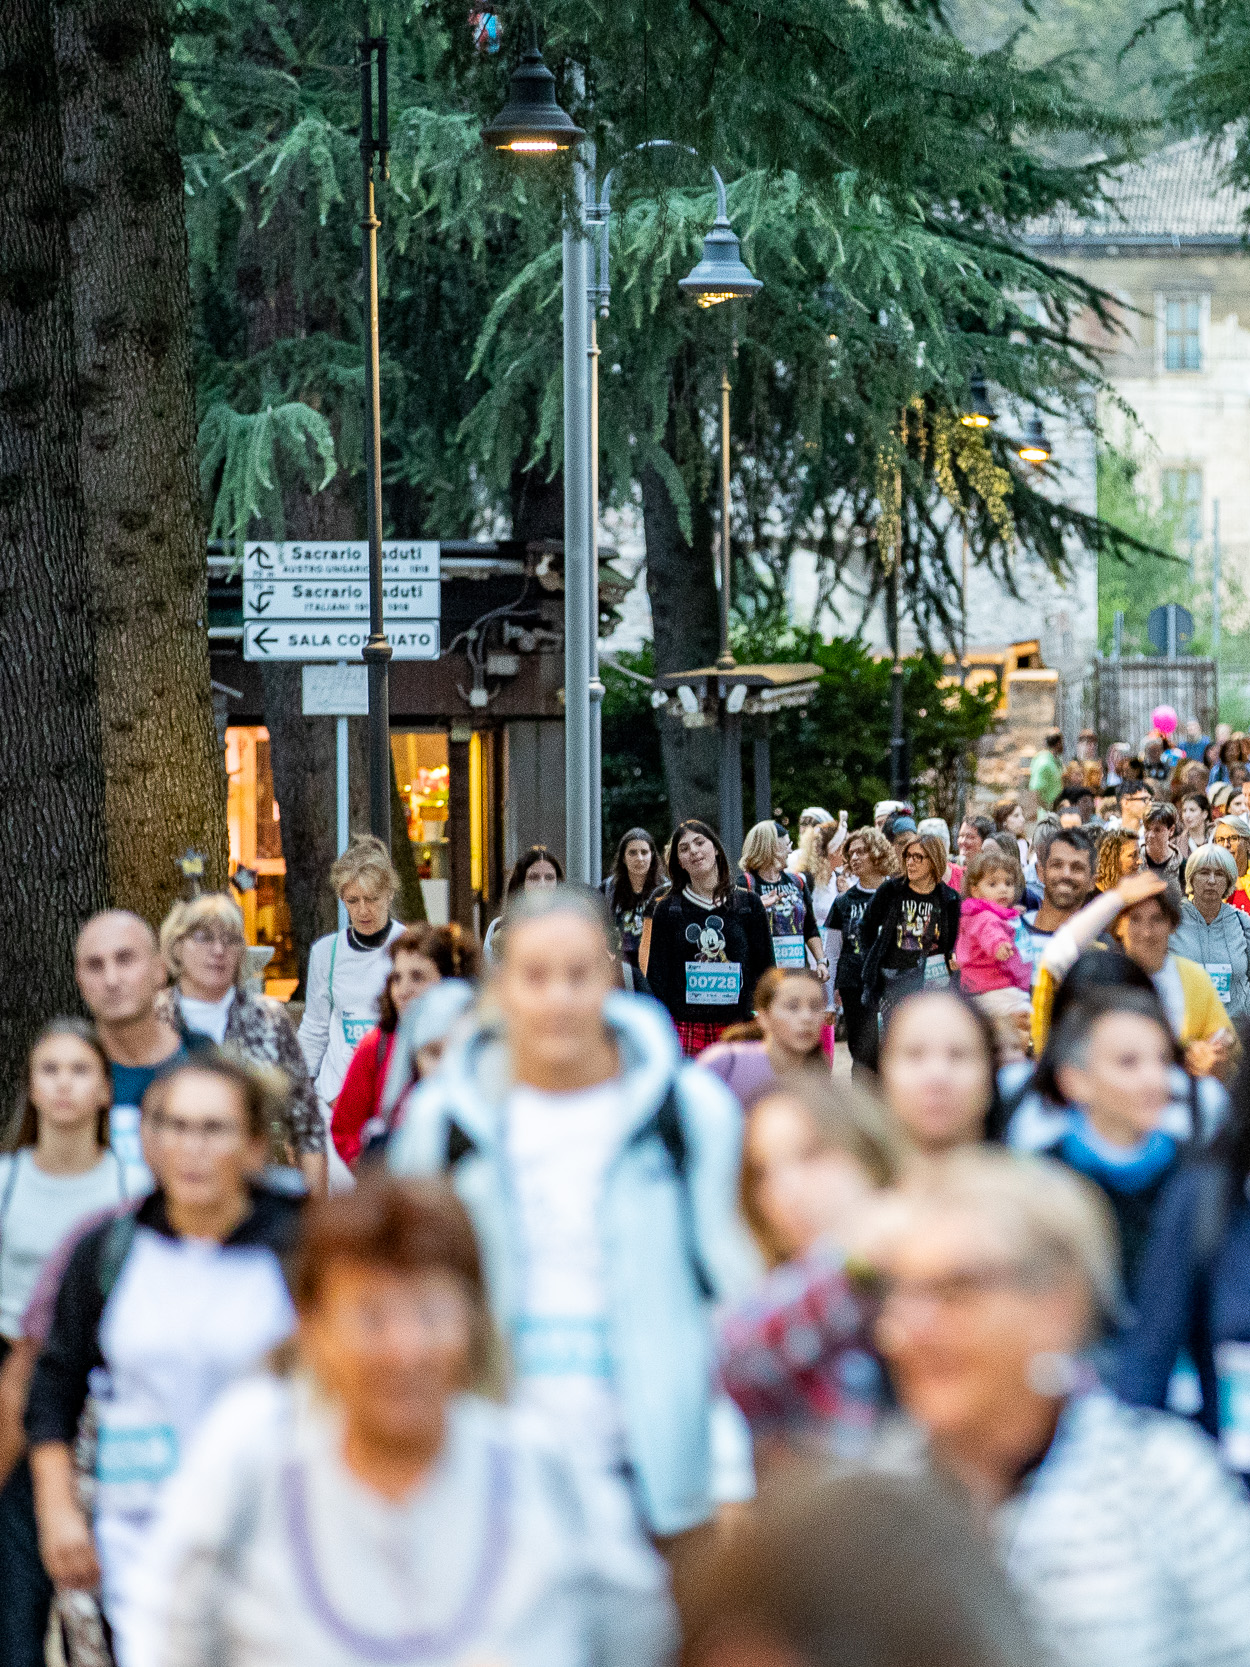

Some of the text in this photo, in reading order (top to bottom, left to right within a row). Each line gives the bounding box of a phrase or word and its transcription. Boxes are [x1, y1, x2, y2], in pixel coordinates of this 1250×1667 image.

[292, 546, 362, 560] Sacrario
[293, 584, 363, 598] Sacrario
[288, 634, 331, 646] SALA
[688, 975, 737, 989] 00728
